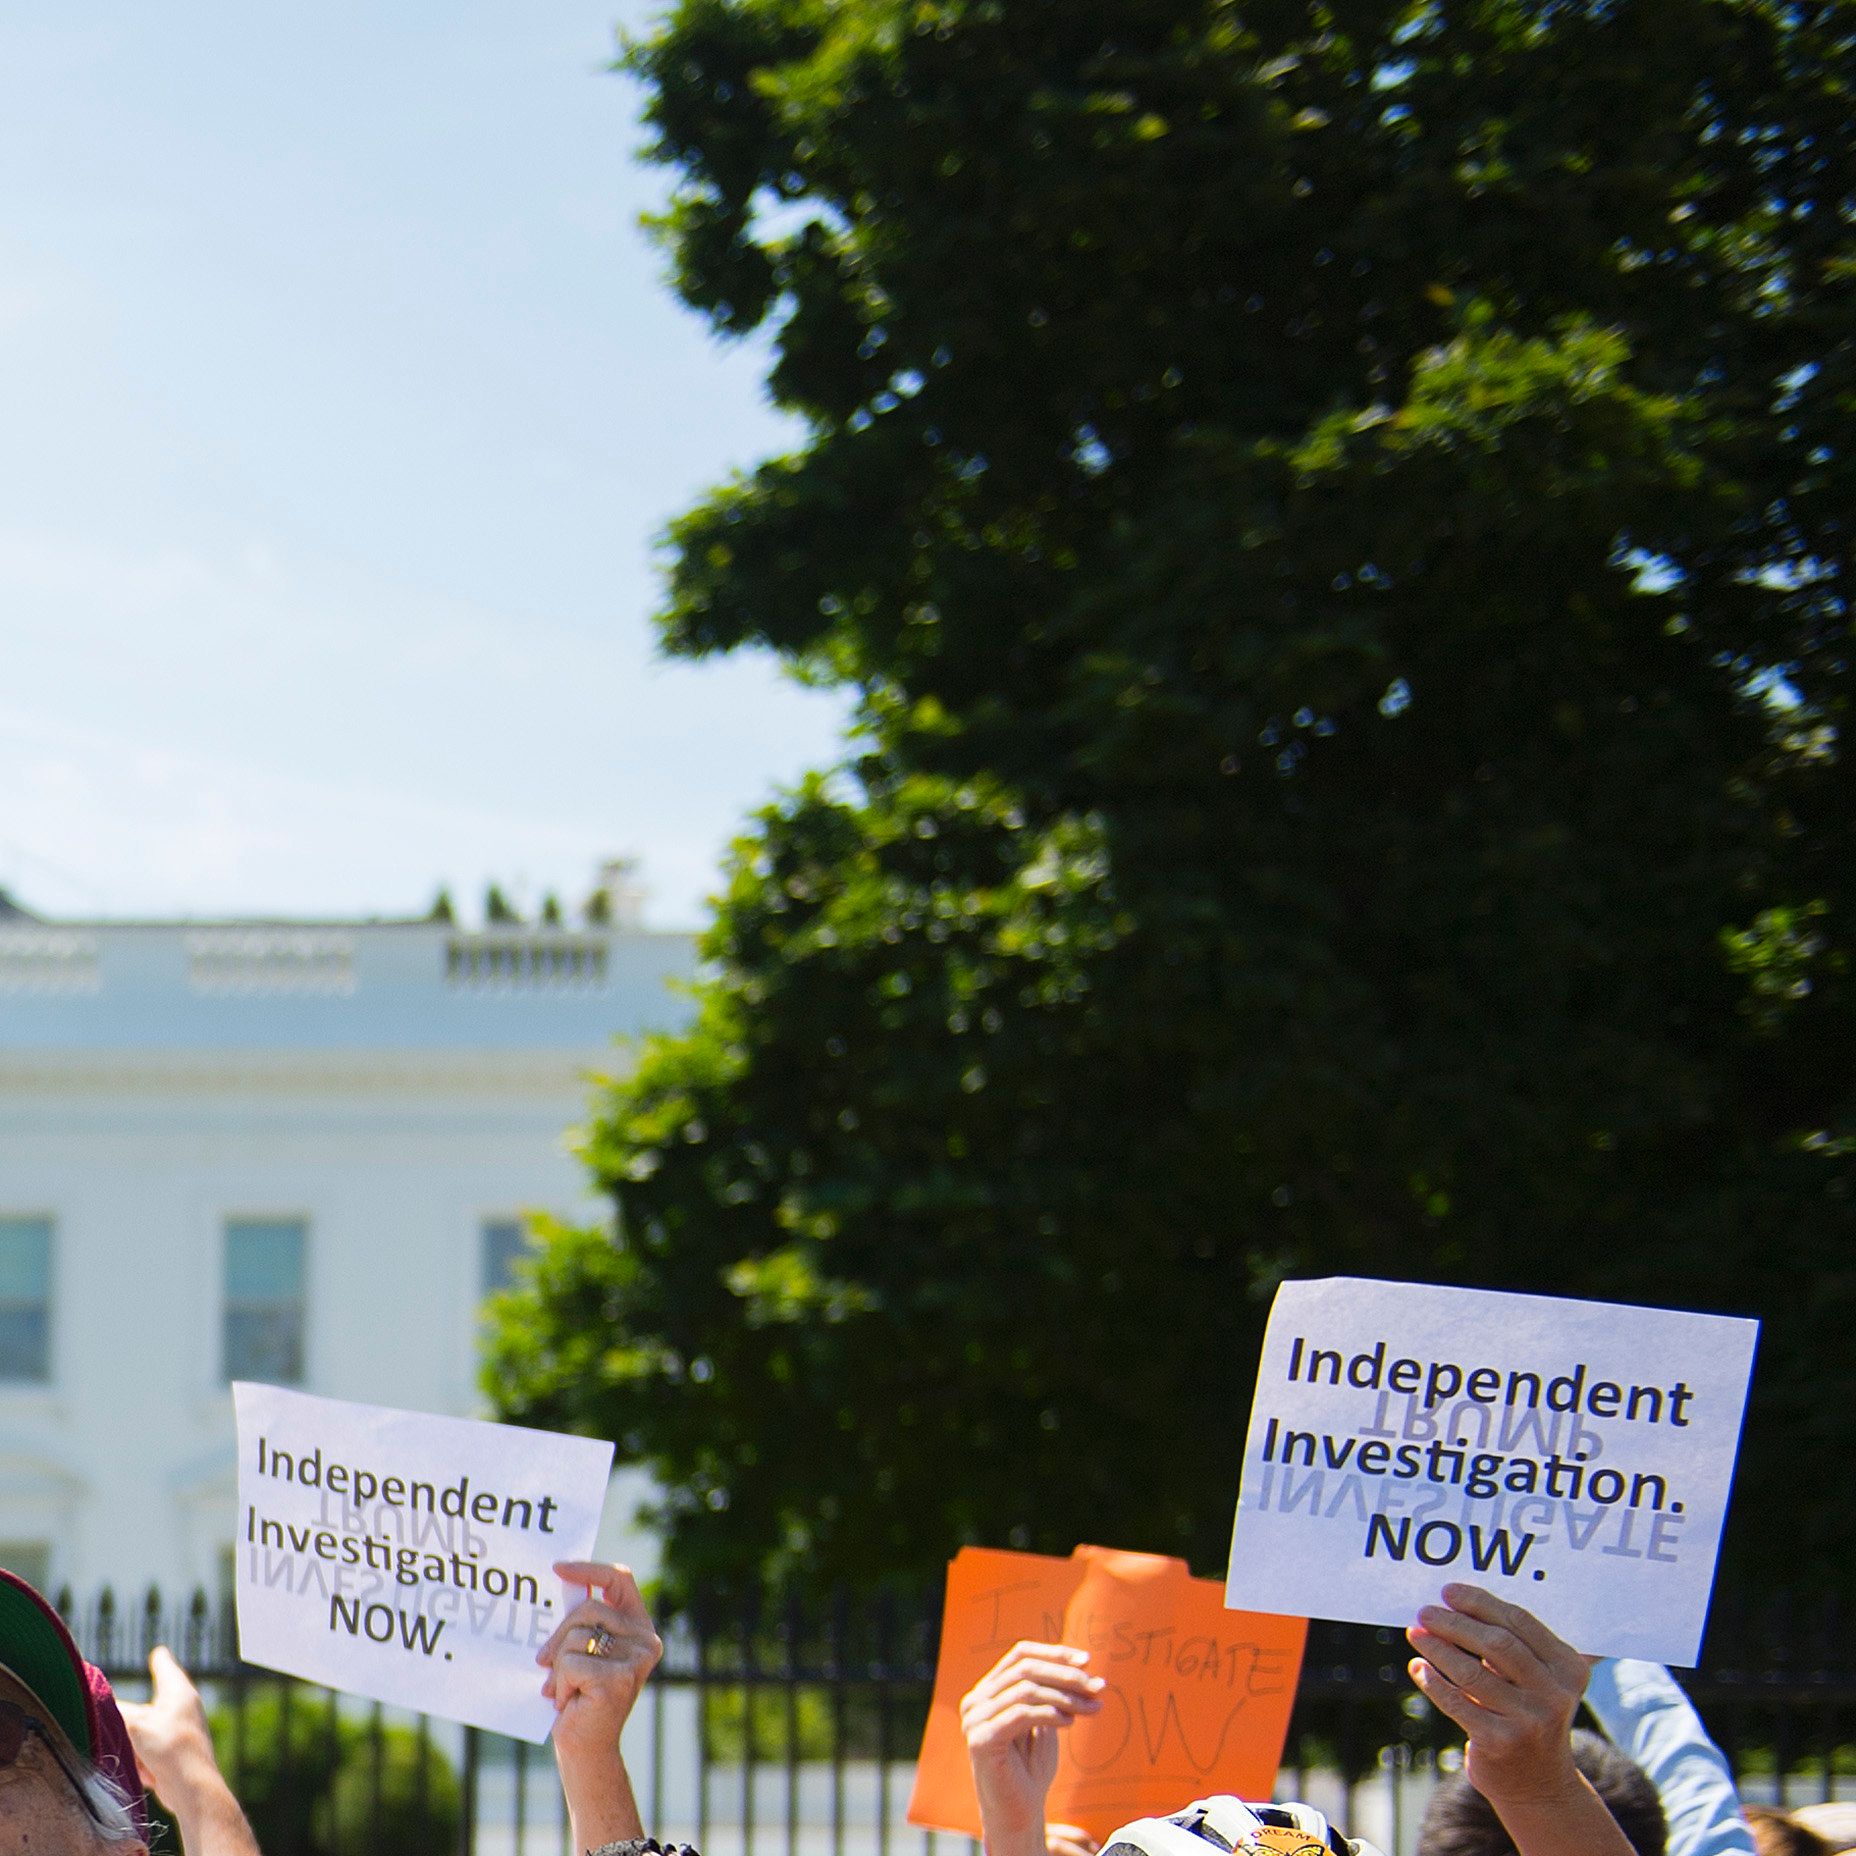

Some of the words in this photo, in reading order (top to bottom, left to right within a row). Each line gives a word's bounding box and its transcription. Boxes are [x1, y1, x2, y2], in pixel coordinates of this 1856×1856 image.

[1286, 1337, 1695, 1428] Independent
[256, 1436, 559, 1534] Independent
[1260, 1417, 1687, 1515] Investigation.
[246, 1504, 554, 1610] Investigation.
[1364, 1513, 1546, 1582] NOW.
[328, 1594, 455, 1663] NOW.
[968, 1580, 1294, 1697] INESTIGATE
[1068, 1680, 1248, 1776] OW
[1250, 1828, 1312, 1842] DREAM
